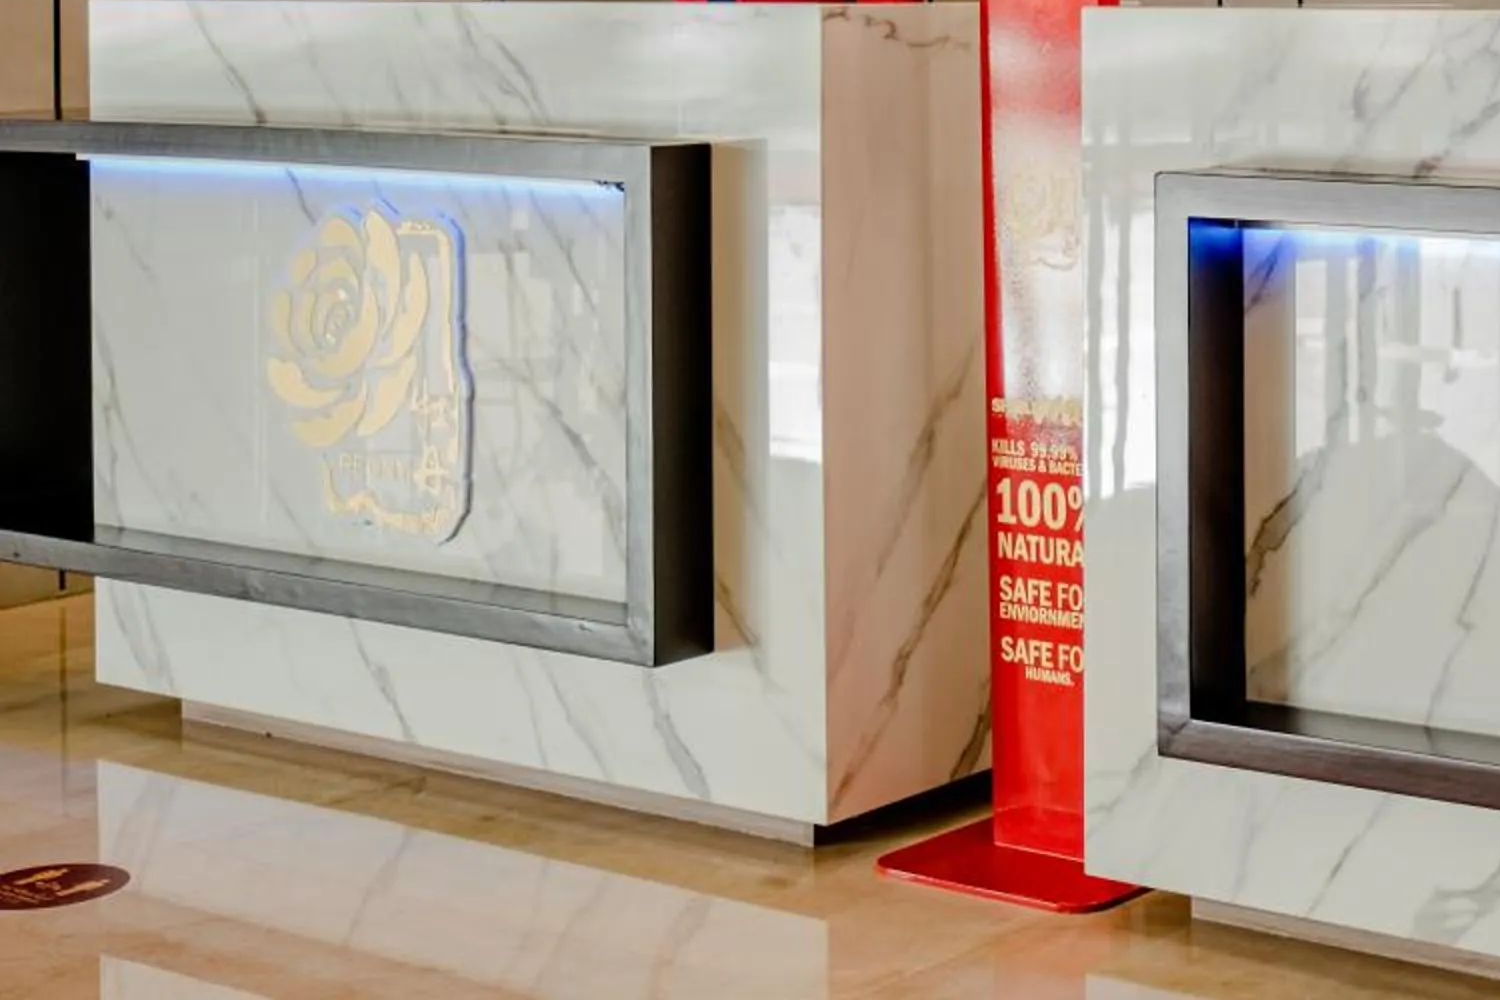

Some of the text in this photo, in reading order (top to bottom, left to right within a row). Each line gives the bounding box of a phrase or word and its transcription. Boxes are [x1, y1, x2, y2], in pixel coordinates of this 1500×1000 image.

[992, 438, 1026, 457] KILLS
[992, 455, 1036, 472] VIRUSES
[1038, 459, 1047, 473] &
[998, 531, 1085, 567] NATURA
[1000, 575, 1084, 611] SAFE FO
[1000, 601, 1085, 629] ENVIORNME
[1001, 635, 1085, 673] SAFE FO
[1025, 665, 1076, 687] HUMANS.
